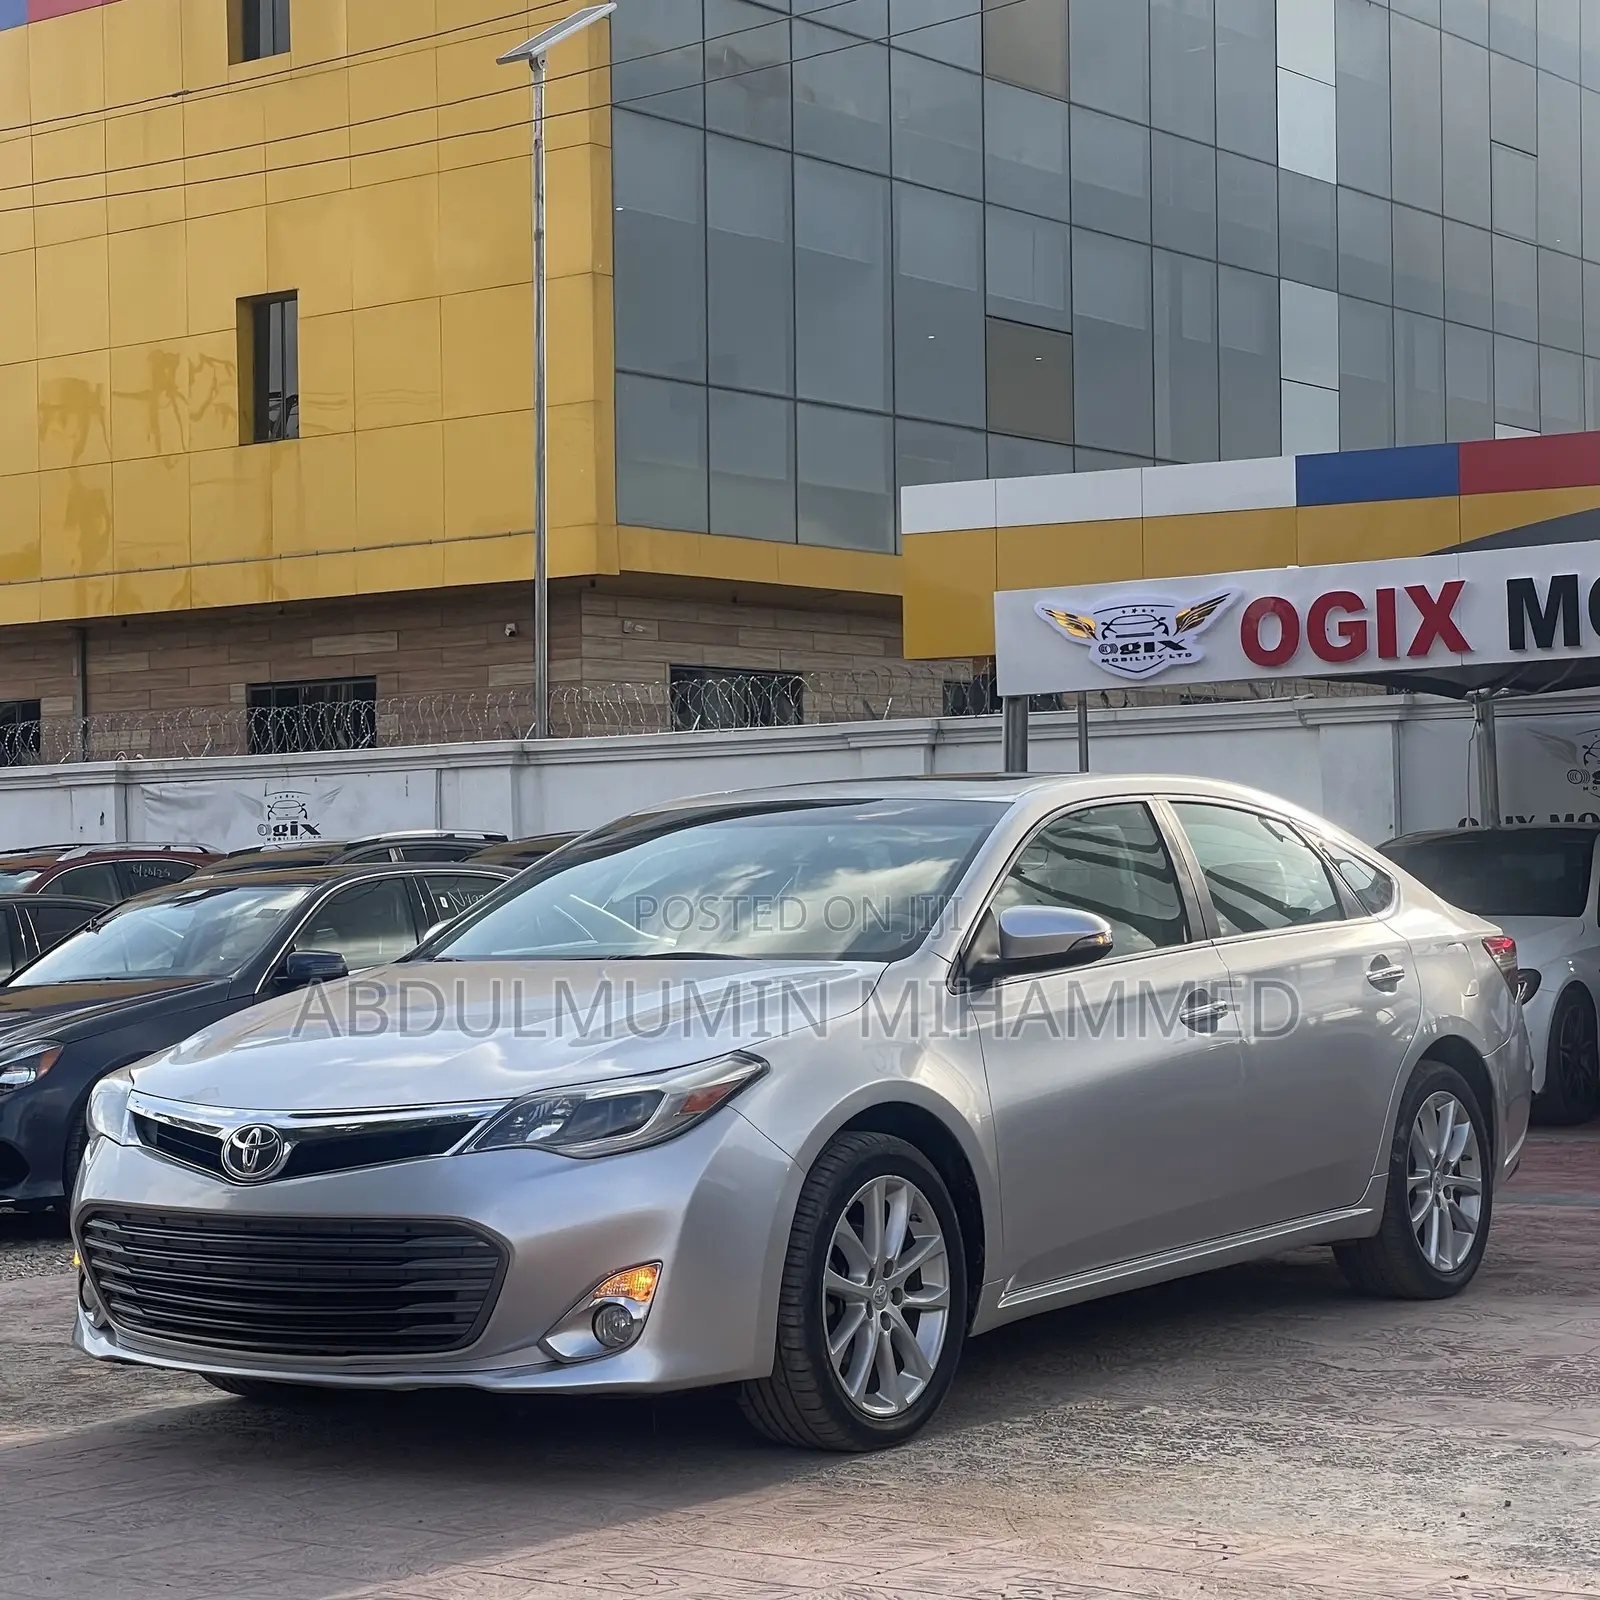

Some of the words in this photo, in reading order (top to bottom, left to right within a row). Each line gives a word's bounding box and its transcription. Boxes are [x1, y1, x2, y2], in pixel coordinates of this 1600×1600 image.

[1240, 580, 1474, 667] OGIX
[1506, 574, 1600, 650] M
[1101, 654, 1164, 663] MOBILITY
